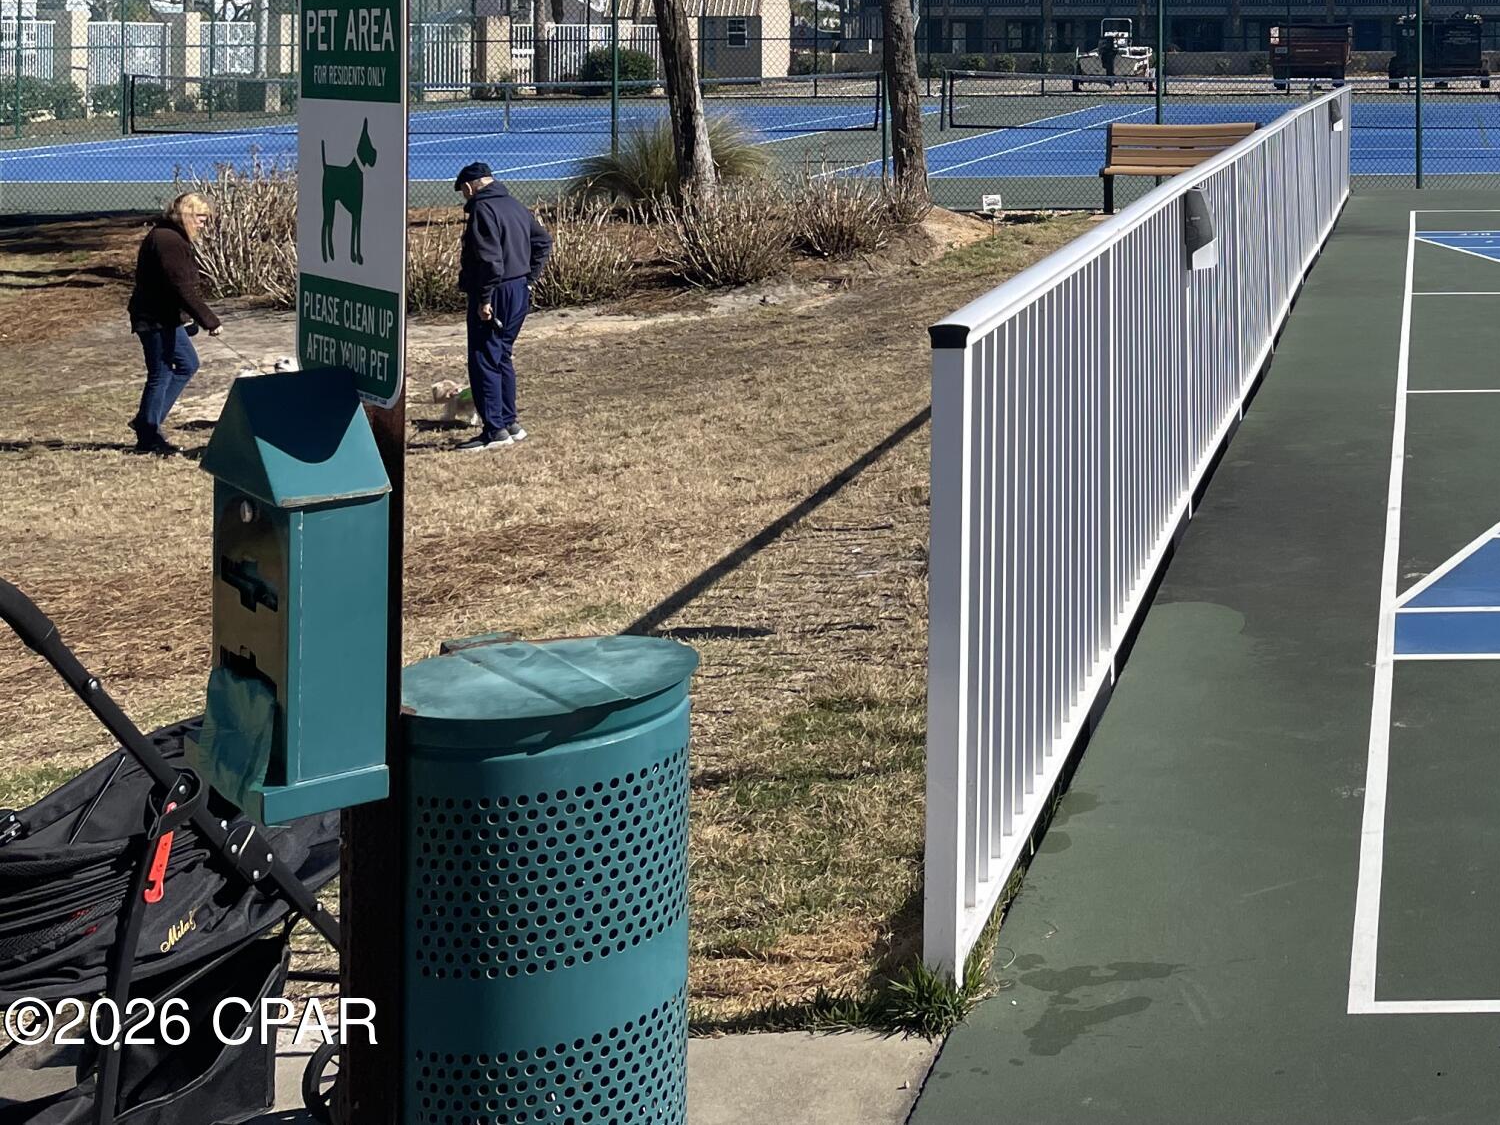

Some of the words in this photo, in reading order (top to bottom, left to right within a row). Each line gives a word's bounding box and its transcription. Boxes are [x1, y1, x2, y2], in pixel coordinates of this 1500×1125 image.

[306, 9, 338, 51] PET
[344, 8, 395, 52] AREA
[313, 65, 328, 85] FOR
[328, 65, 365, 86] RESIDENTS
[367, 66, 386, 87] ONLY
[303, 290, 340, 326] PLEASE
[343, 299, 375, 335] CLEAN
[379, 308, 394, 340] UP
[306, 332, 337, 367] AFTER
[340, 340, 366, 376] YOUR
[369, 349, 389, 382] PET
